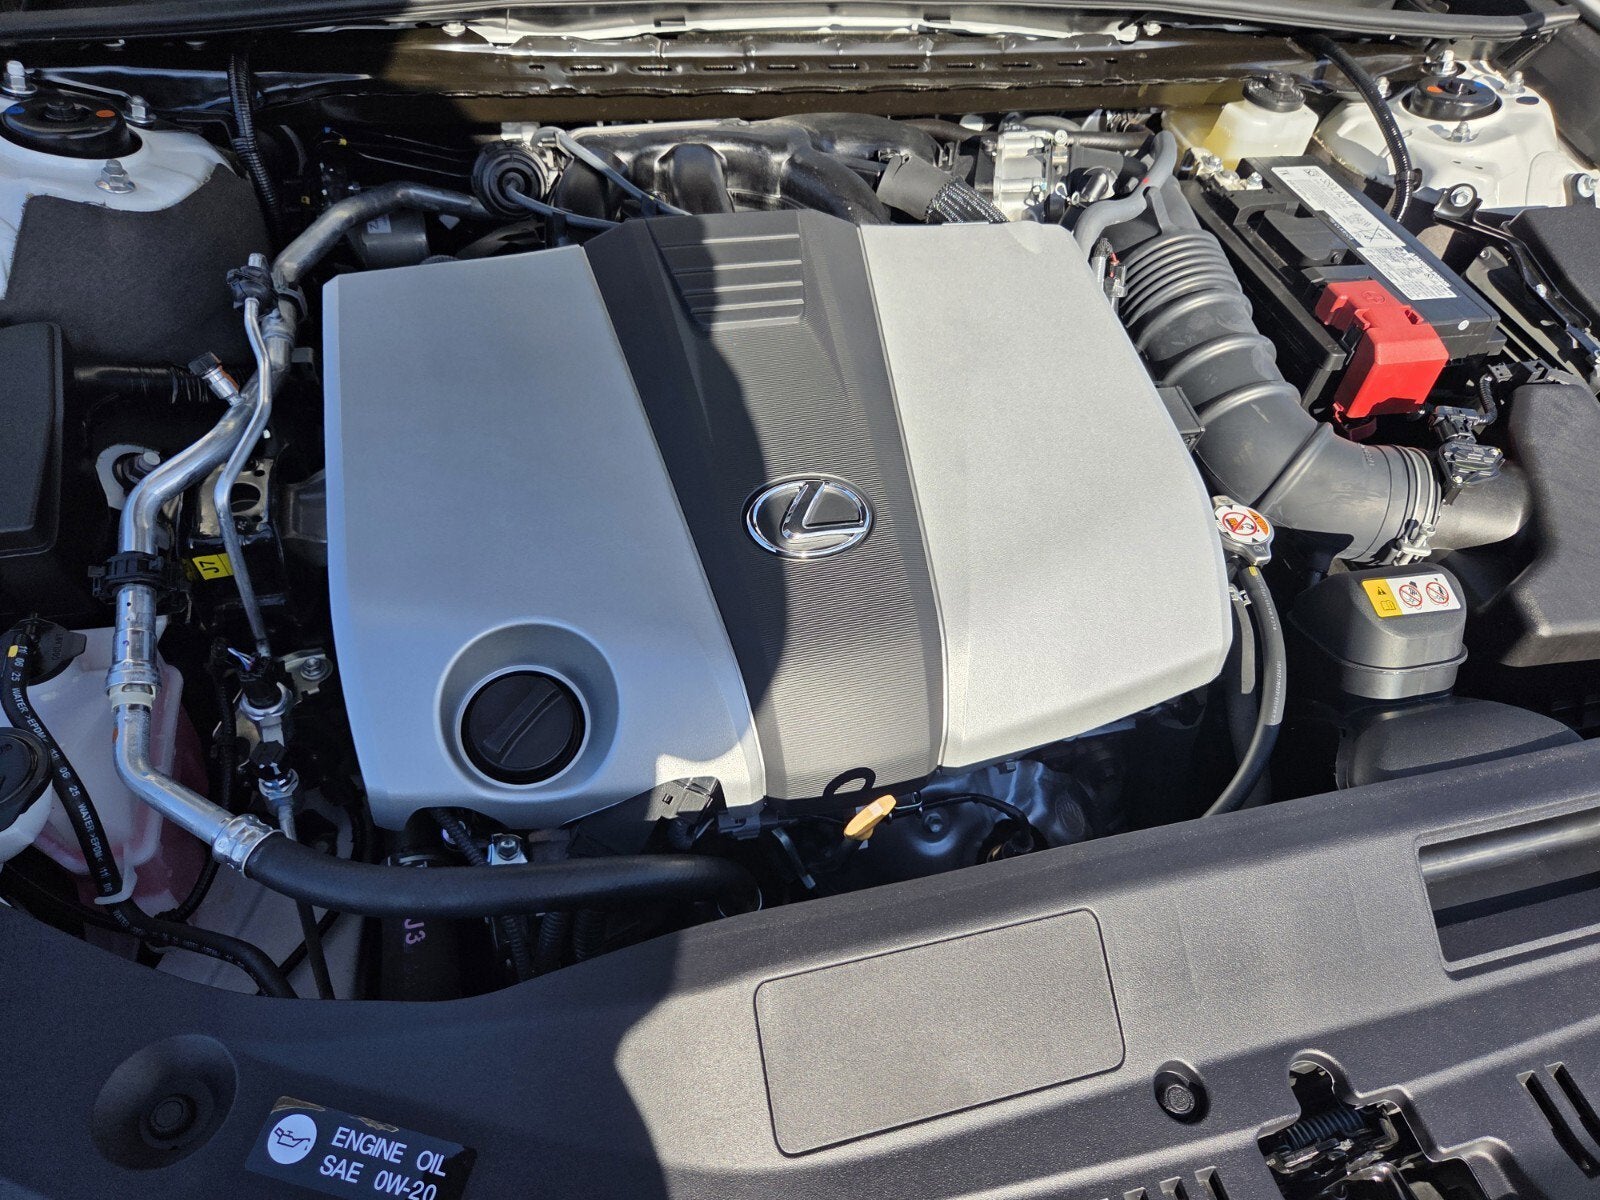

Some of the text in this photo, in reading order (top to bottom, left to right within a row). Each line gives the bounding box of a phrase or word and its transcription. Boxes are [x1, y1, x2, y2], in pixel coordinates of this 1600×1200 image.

[198, 560, 220, 574] J7
[11, 671, 21, 682] 25
[11, 687, 28, 714] WATER
[59, 766, 71, 779] 06
[68, 785, 80, 797] 25
[78, 802, 95, 832] WATER
[404, 918, 426, 945] J3
[331, 1126, 447, 1177] ENGINE OIL
[319, 1154, 437, 1200] SAE 0W-20
